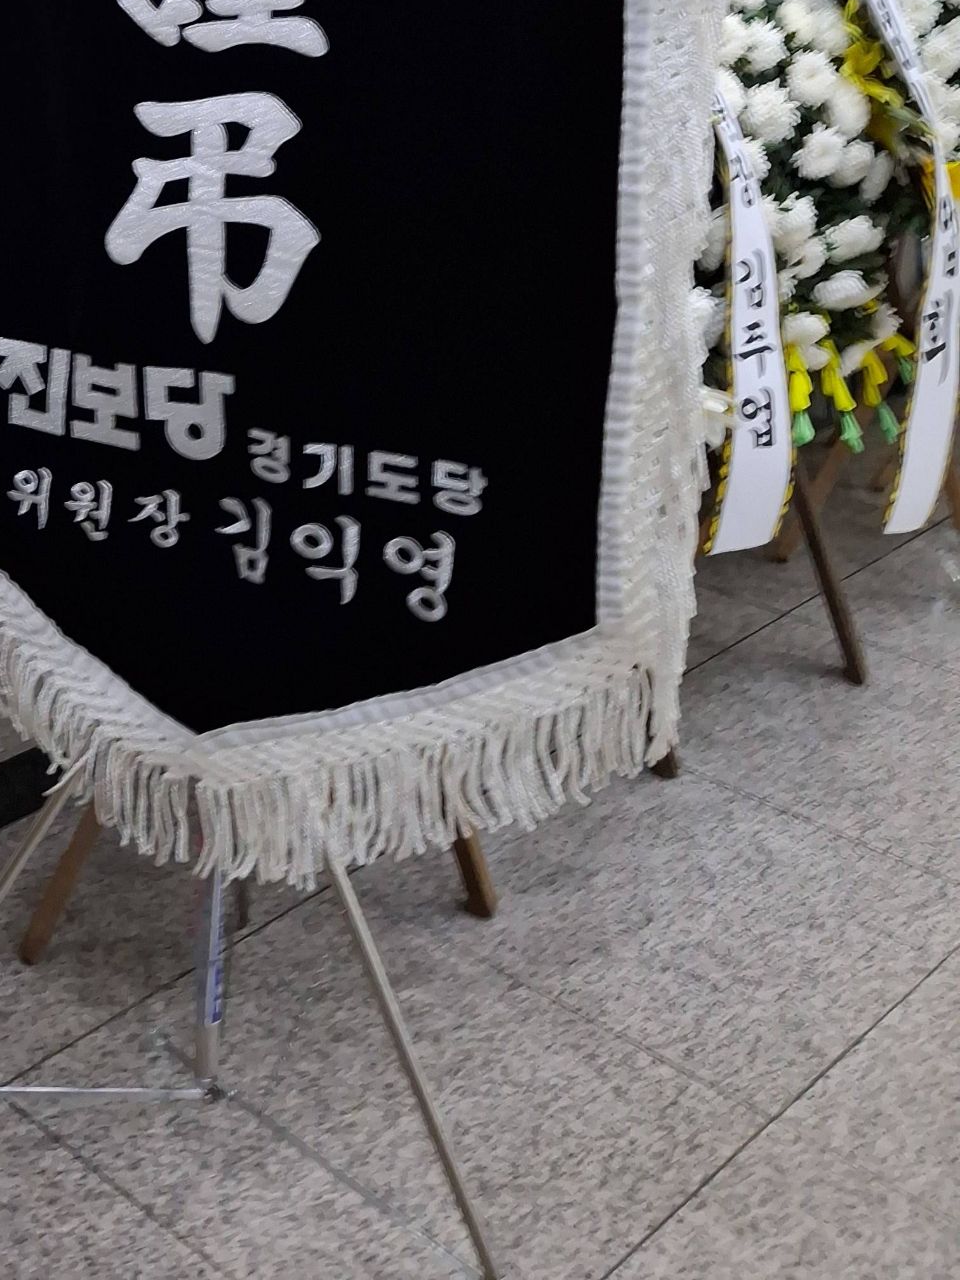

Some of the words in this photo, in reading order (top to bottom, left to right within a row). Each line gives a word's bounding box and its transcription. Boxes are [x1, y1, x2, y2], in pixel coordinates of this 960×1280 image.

[248, 428, 489, 517] 경기도당
[6, 466, 190, 549] 위원장
[214, 497, 456, 623] 김익영
